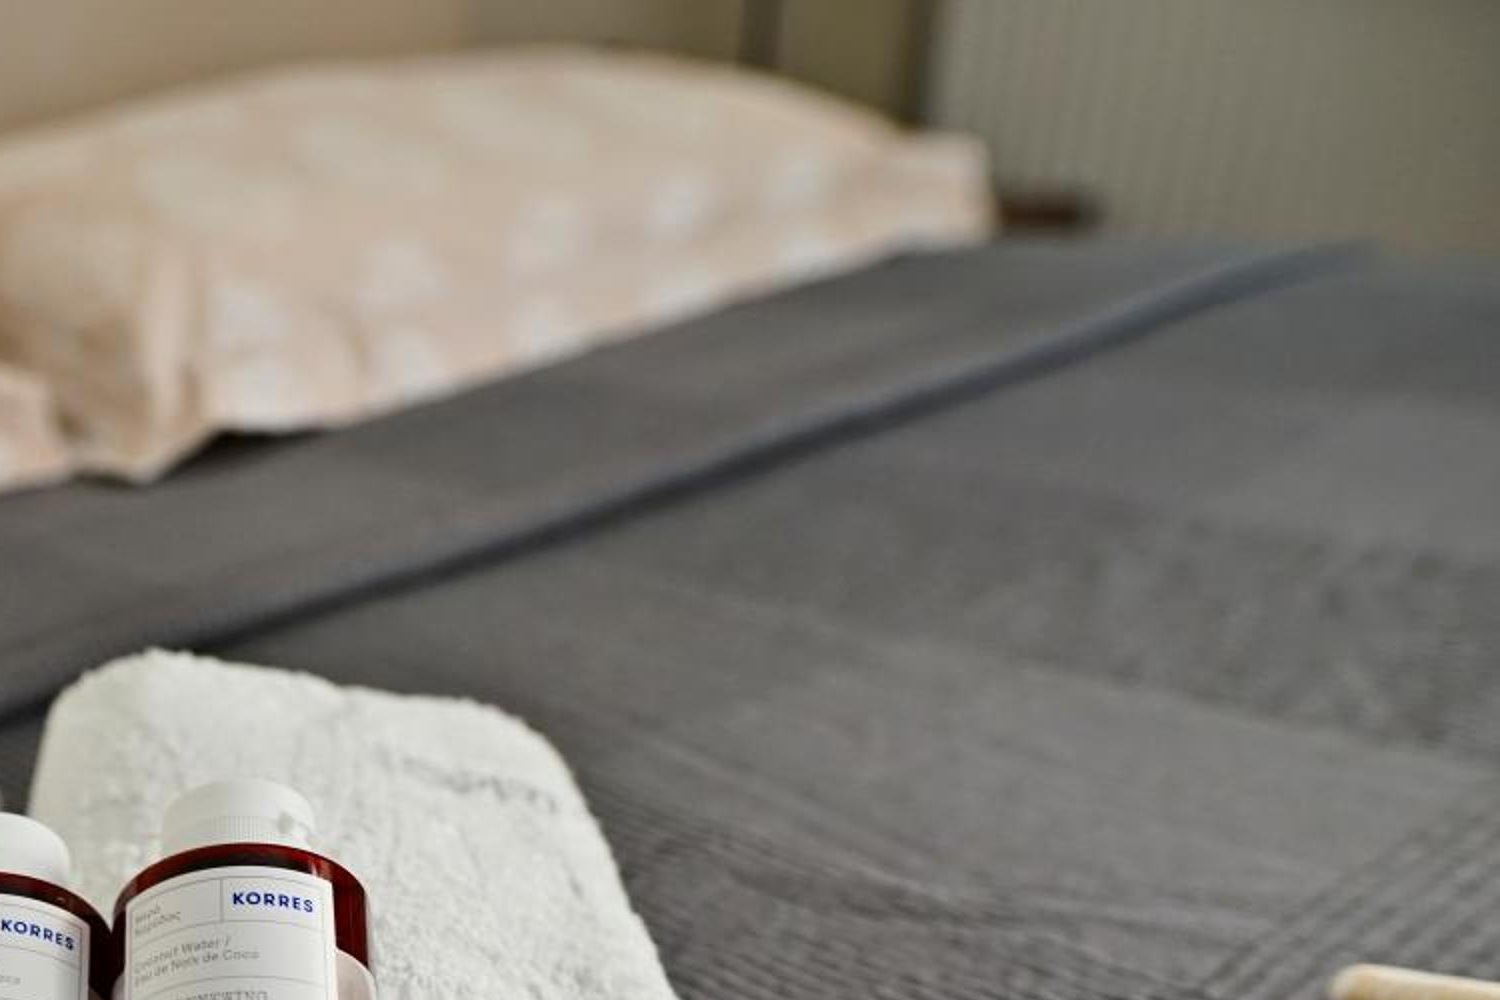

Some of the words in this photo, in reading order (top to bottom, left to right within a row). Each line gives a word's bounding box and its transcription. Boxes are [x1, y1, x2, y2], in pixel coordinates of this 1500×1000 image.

[232, 892, 315, 914] KORRES
[0, 918, 76, 951] KORRES
[181, 938, 222, 954] Water
[202, 951, 219, 964] de
